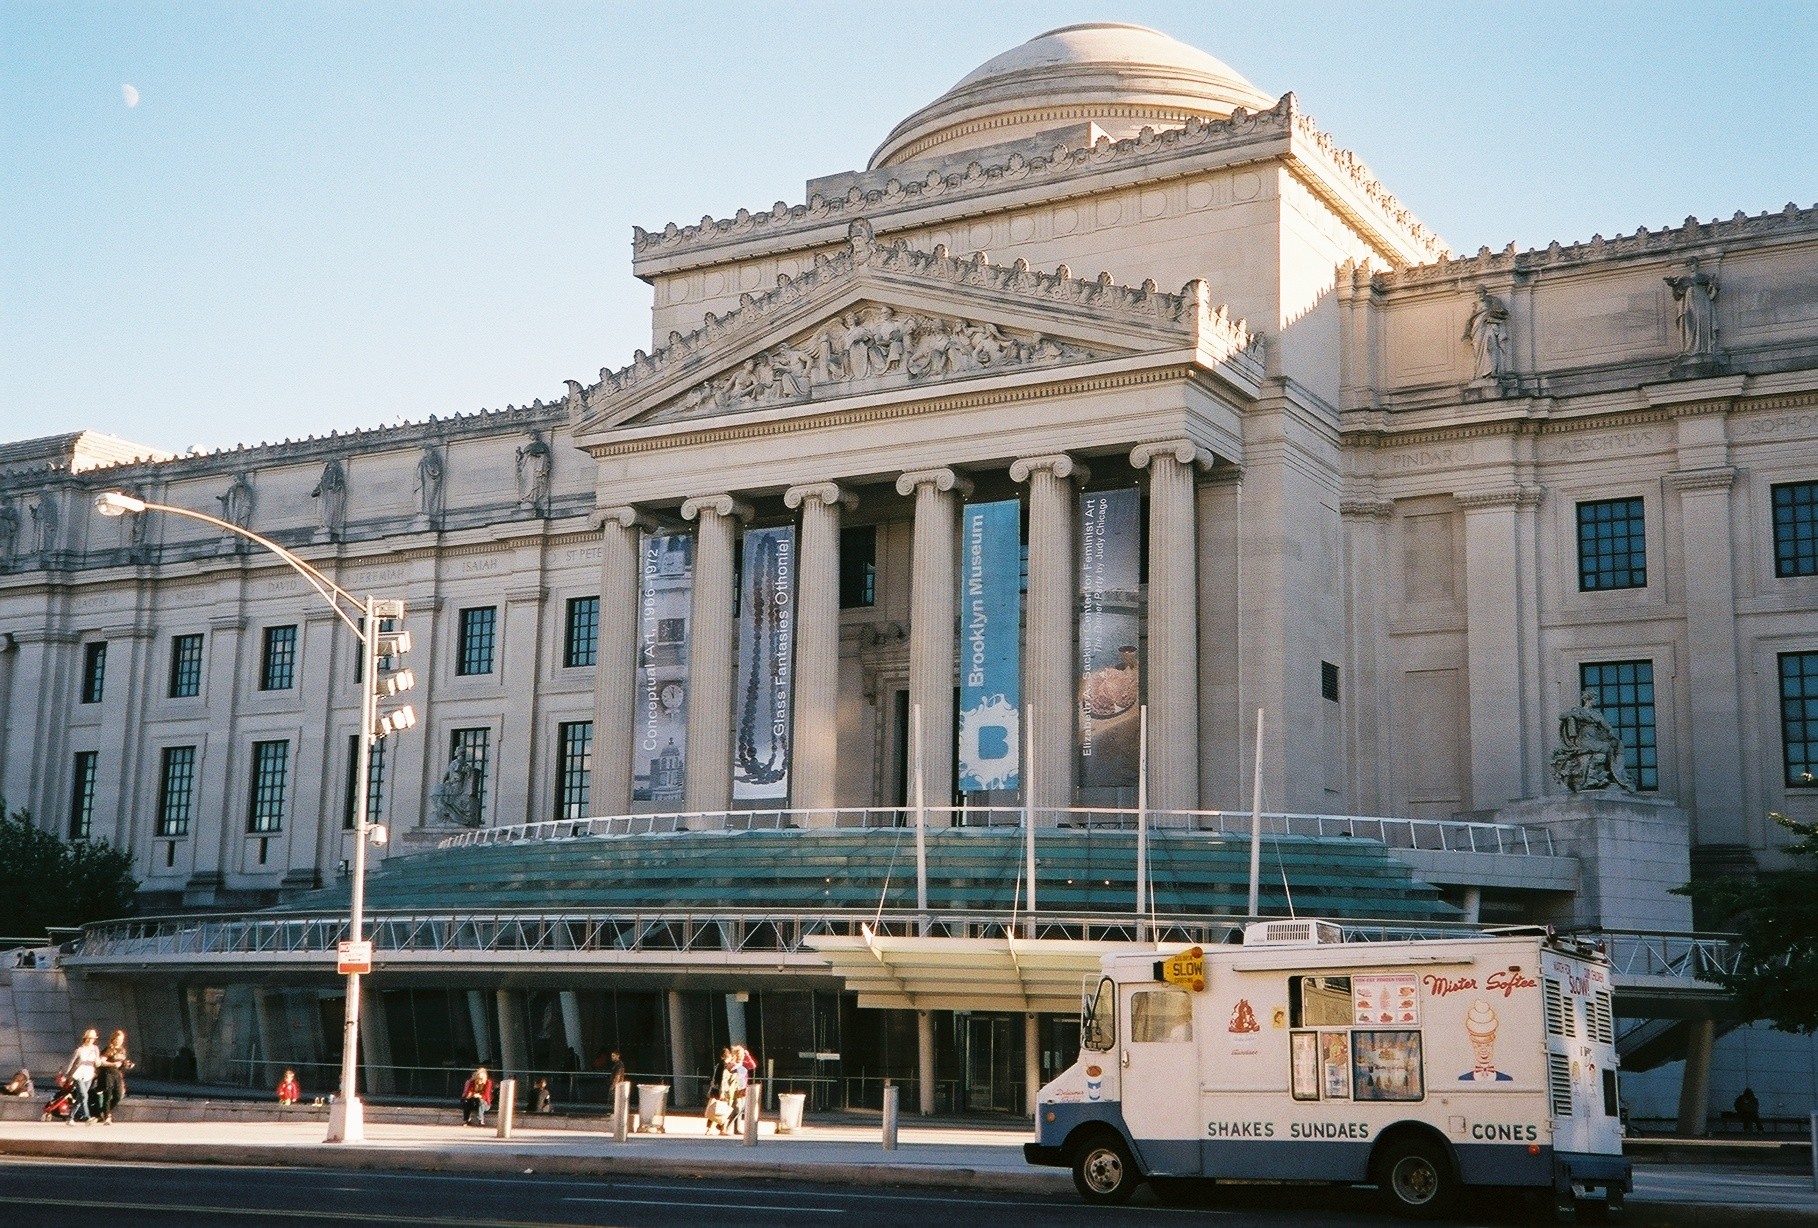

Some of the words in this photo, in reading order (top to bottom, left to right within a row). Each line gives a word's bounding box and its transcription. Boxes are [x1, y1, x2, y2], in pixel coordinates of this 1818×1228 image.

[1392, 449, 1455, 469] PINDAR
[1085, 498, 1096, 518] Art
[1096, 498, 1108, 536] Chicago
[579, 547, 602, 560] PETE
[968, 514, 984, 596] Museum
[1084, 521, 1094, 570] Feminist
[1096, 537, 1106, 560] Judy
[353, 568, 405, 584] JEREMIAH
[462, 557, 498, 573] ISAIAH
[774, 539, 790, 605] Othoniel
[1096, 562, 1105, 573] by
[268, 580, 297, 593] DAVID
[1083, 575, 1092, 590] for
[1094, 576, 1105, 600] Party
[1083, 592, 1092, 632] Center
[643, 628, 657, 658] Art,
[775, 610, 789, 686] Fantasies
[968, 600, 988, 688] Brooklyn
[1083, 638, 1092, 680] Sackler
[643, 663, 660, 751] Conceptual
[773, 691, 786, 737] Glass
[1083, 699, 1092, 756] Elizabeth
[978, 725, 1009, 760] B
[1172, 962, 1203, 976] SLOW
[1423, 974, 1478, 997] Mister
[1485, 971, 1538, 998] Softee
[1208, 1121, 1275, 1137] SHAKES
[1290, 1122, 1369, 1138] SUNDAES
[1472, 1124, 1538, 1141] CONES
